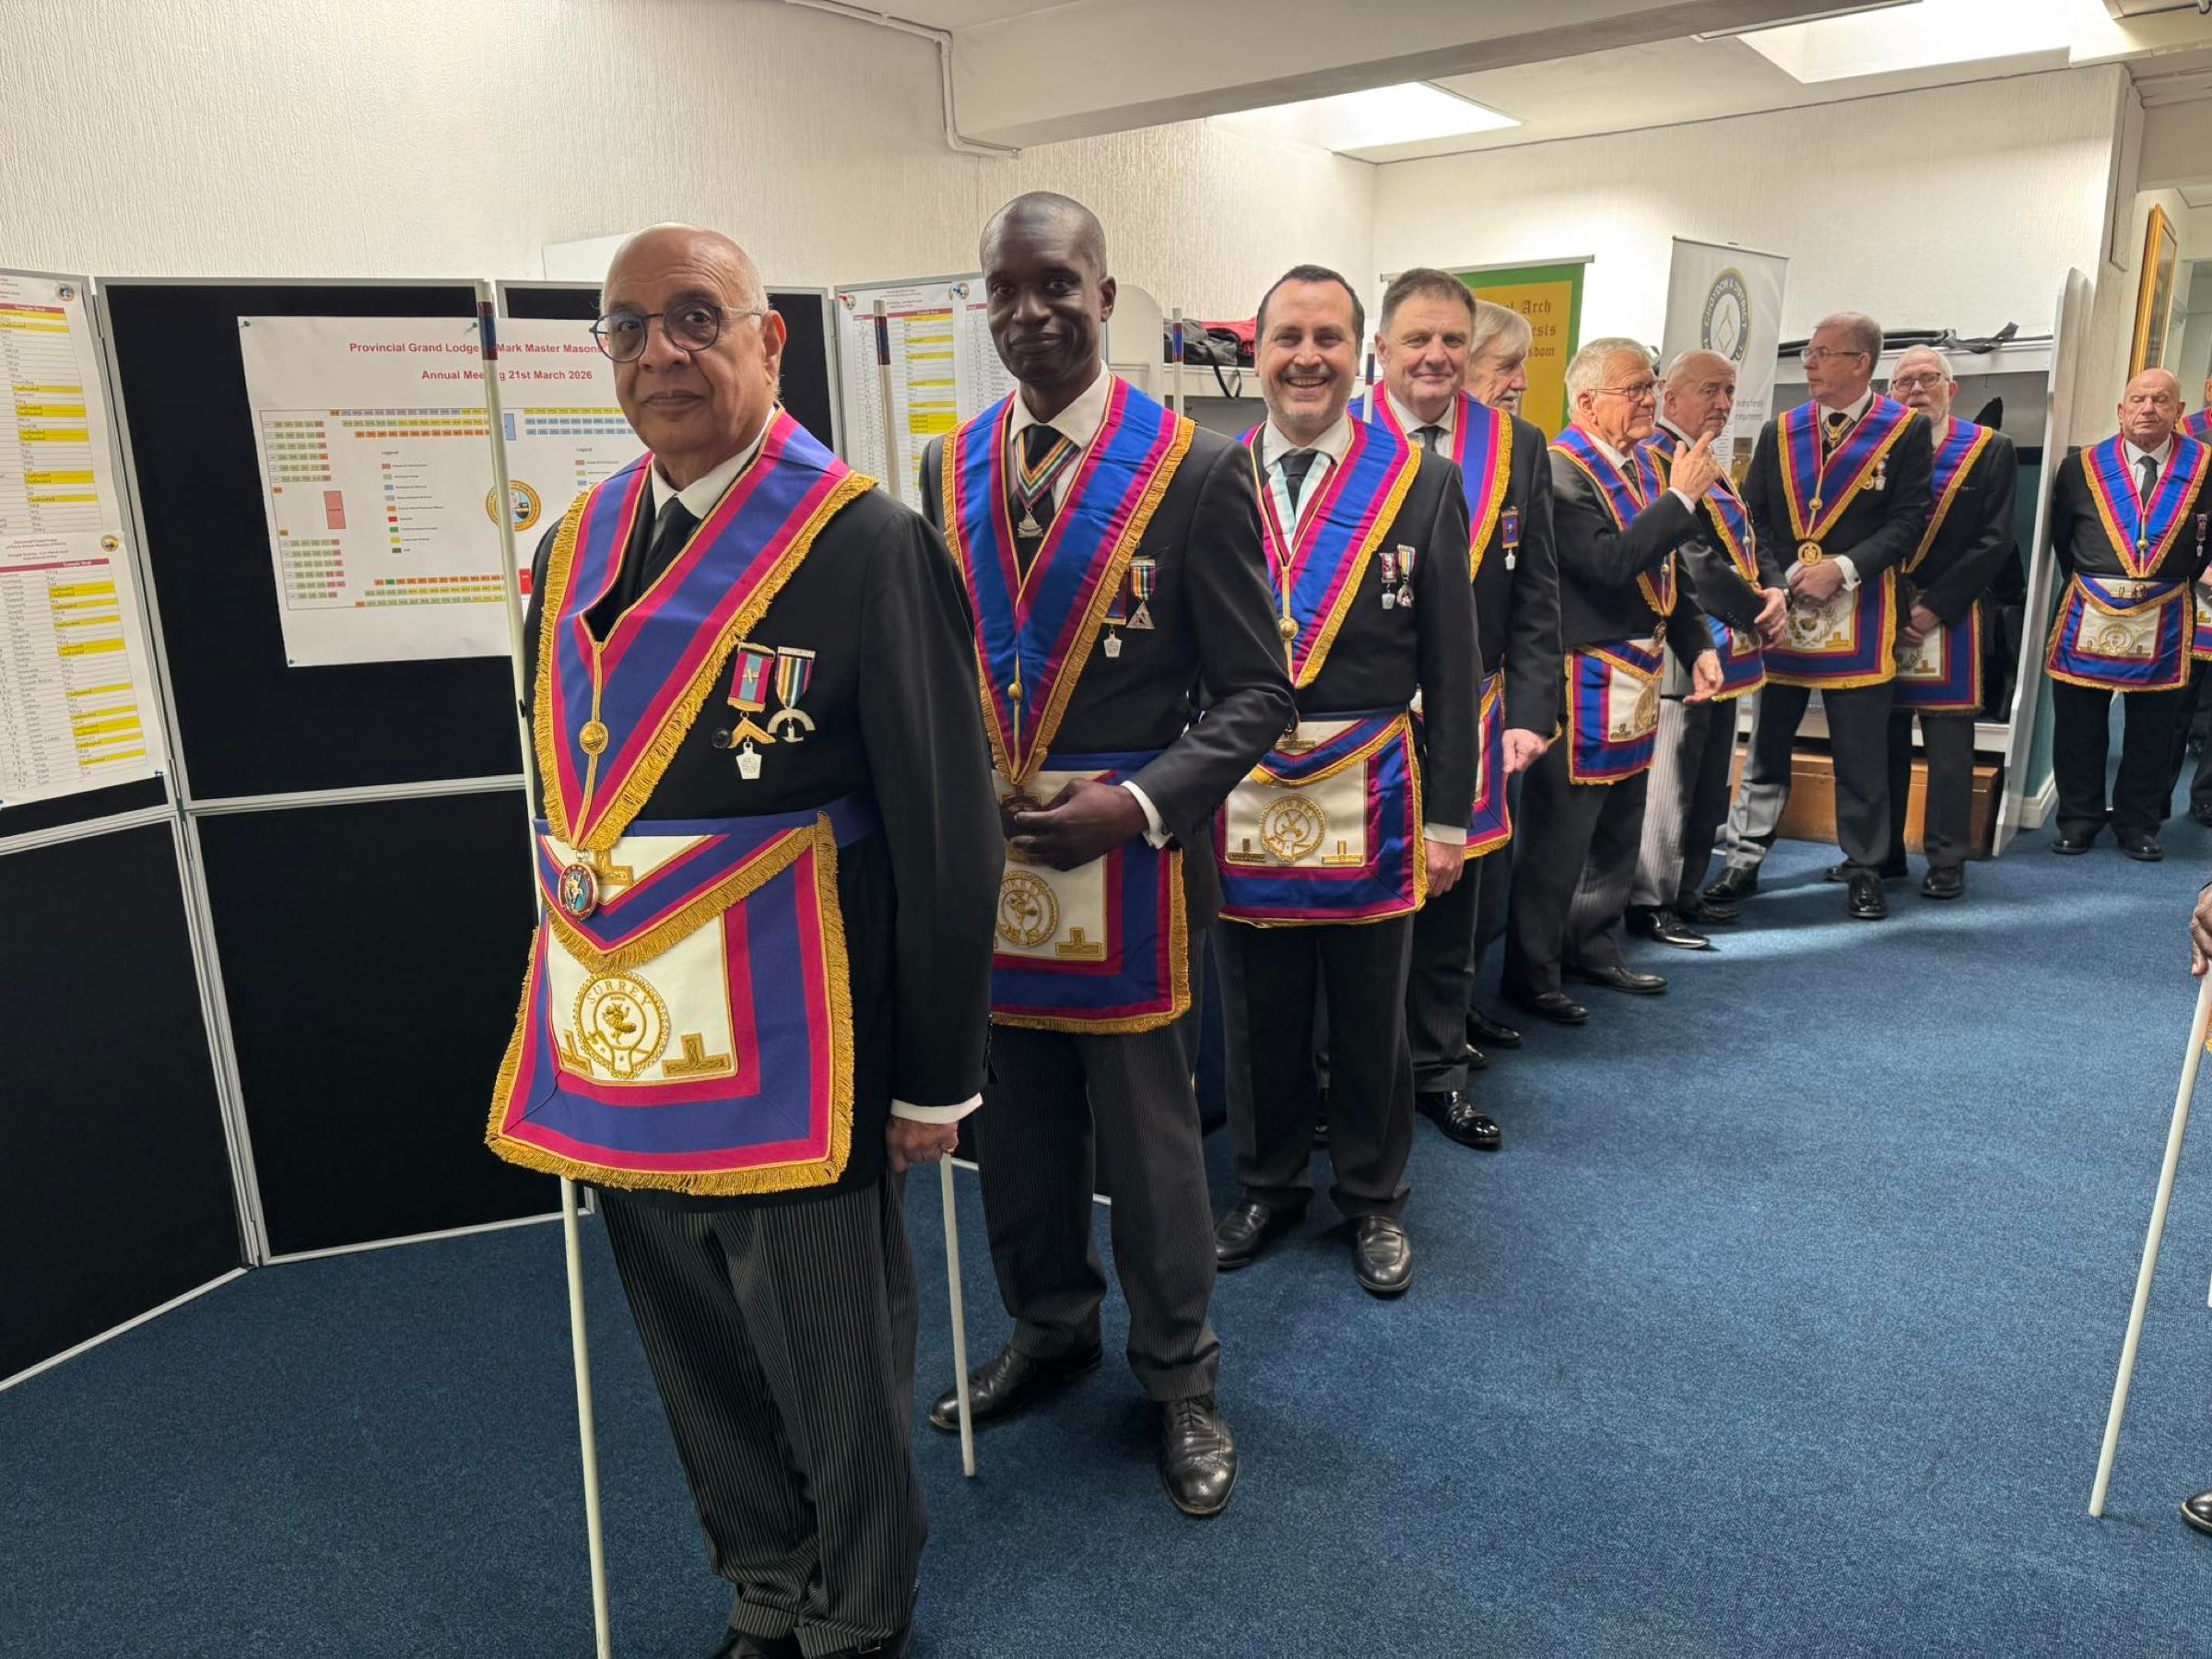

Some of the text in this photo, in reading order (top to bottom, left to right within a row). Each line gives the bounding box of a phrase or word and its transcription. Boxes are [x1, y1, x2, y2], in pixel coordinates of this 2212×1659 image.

[1521, 300, 1551, 314] Arch
[1533, 324, 1557, 337] ests
[348, 343, 604, 354] Provincial Grand Lodge Mark Master Masons
[421, 371, 593, 382] Annual Meeg 21st March 2026
[586, 980, 652, 1006] SURREY
